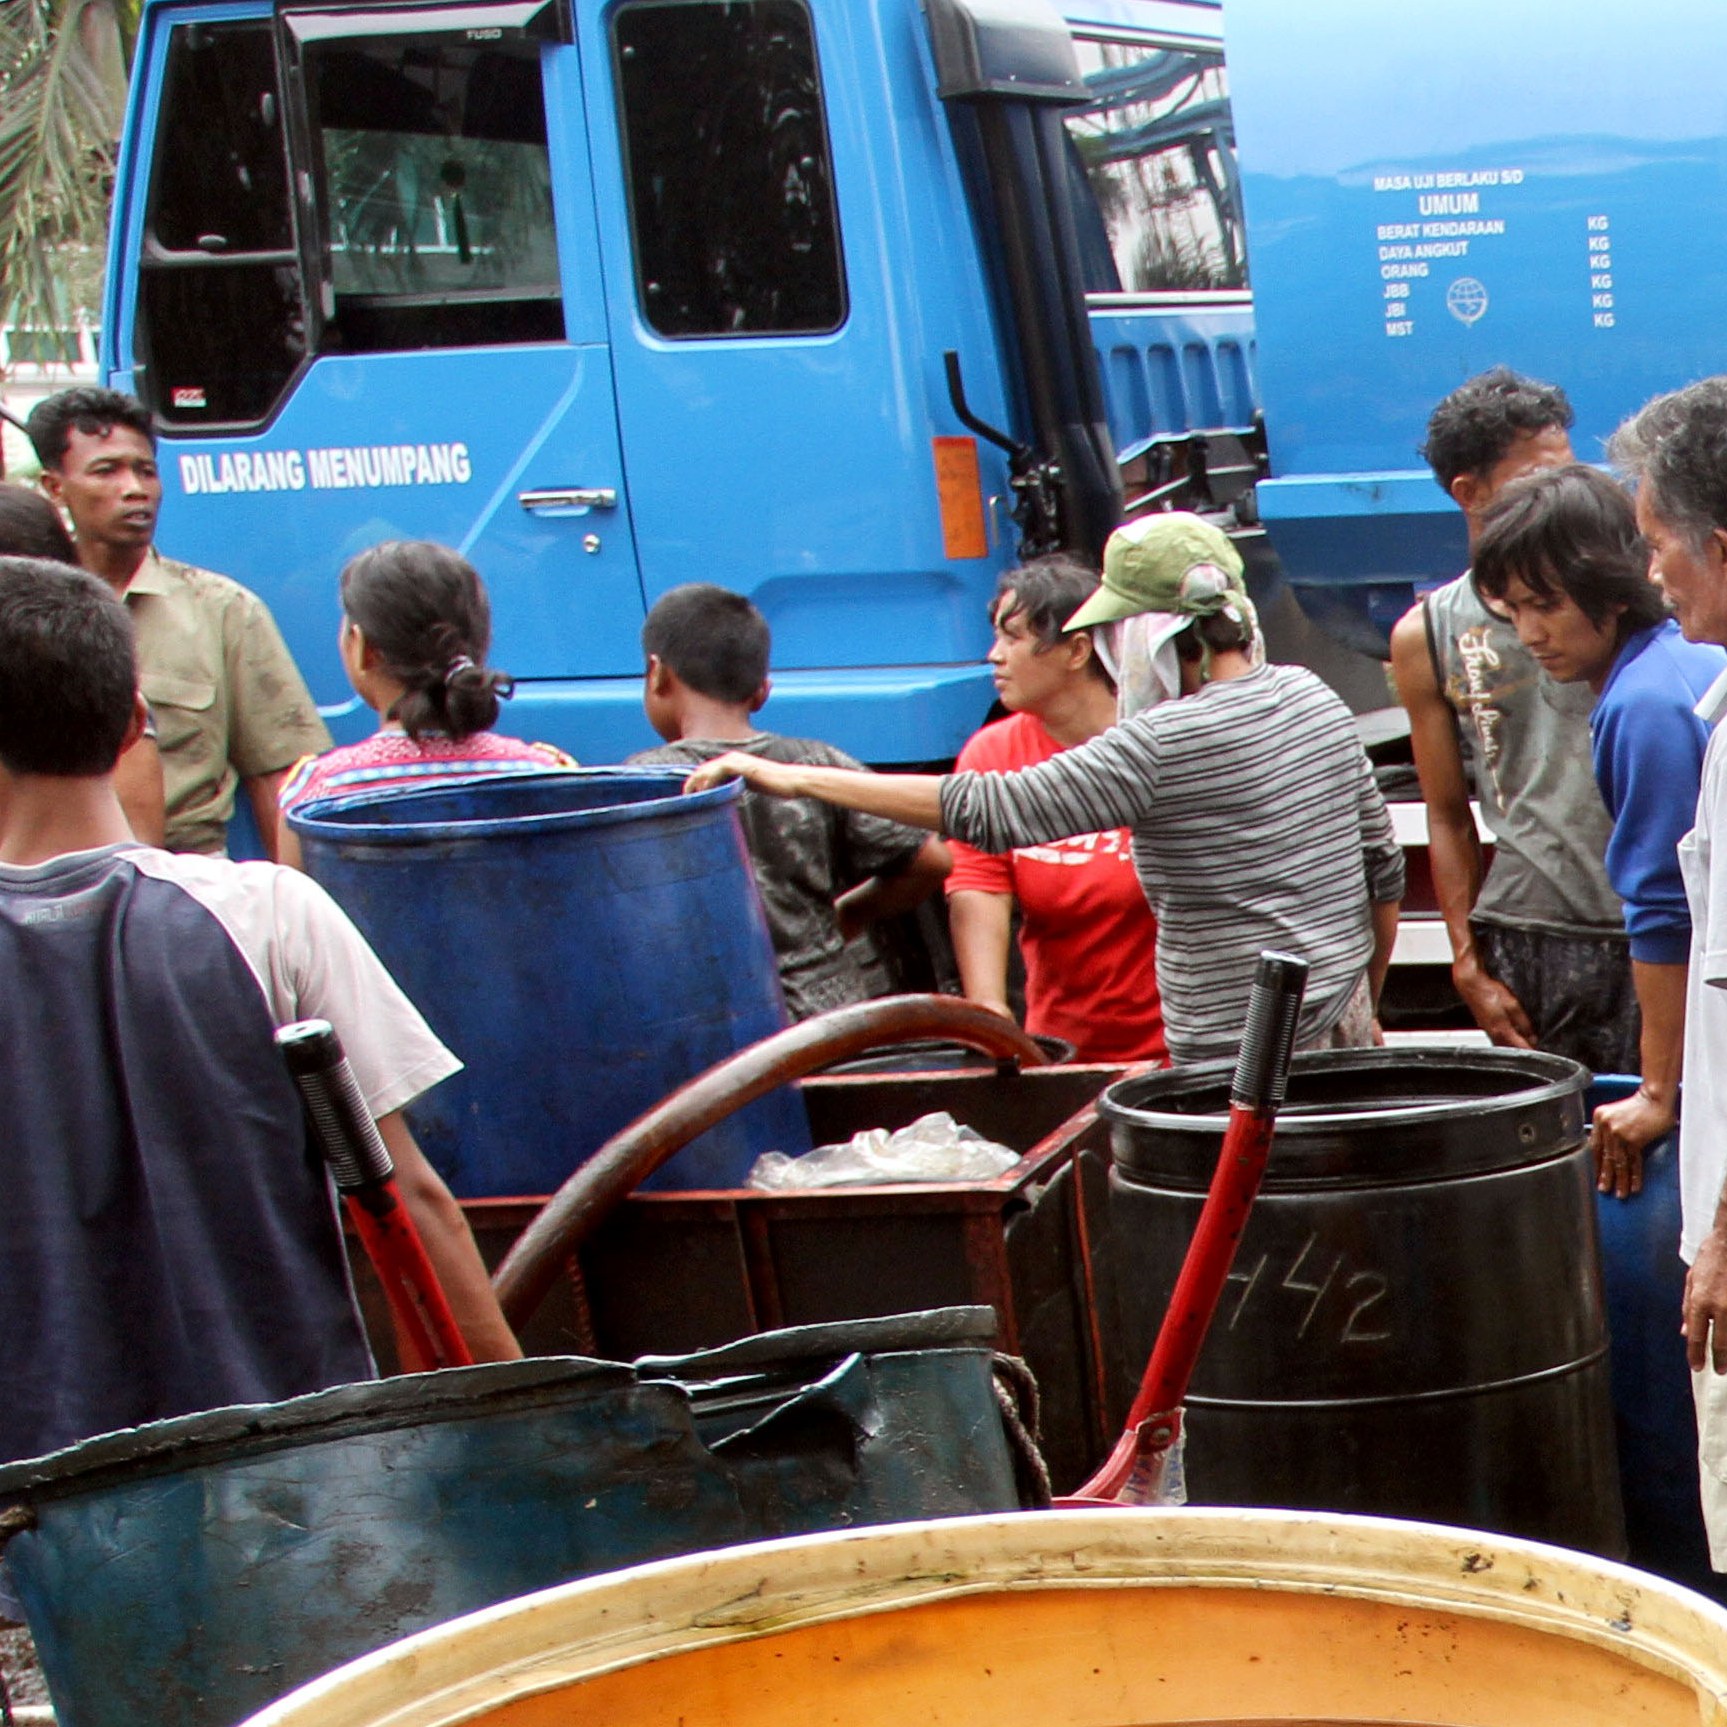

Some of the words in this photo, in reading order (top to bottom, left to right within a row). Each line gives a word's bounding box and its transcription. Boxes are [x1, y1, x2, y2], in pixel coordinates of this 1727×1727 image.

[1373, 176, 1410, 192] MASA
[1413, 174, 1434, 189] UJI
[1436, 171, 1498, 188] BERLAKU
[1418, 193, 1480, 216] UMUM
[1377, 224, 1420, 240] BERAT
[1422, 220, 1505, 238] KENDARAAN
[1587, 216, 1609, 231] KG
[1379, 245, 1415, 261] DAYA
[1415, 240, 1470, 259] ANGKUT
[1588, 236, 1610, 251] KG
[1380, 263, 1429, 279] ORANG
[1589, 255, 1611, 270] KG
[1591, 274, 1613, 289] KG
[1592, 294, 1614, 308] KG
[1386, 321, 1414, 337] MST
[1593, 313, 1615, 329] KG
[180, 450, 306, 495] DILARANG
[308, 443, 471, 491] MENUMPANG
